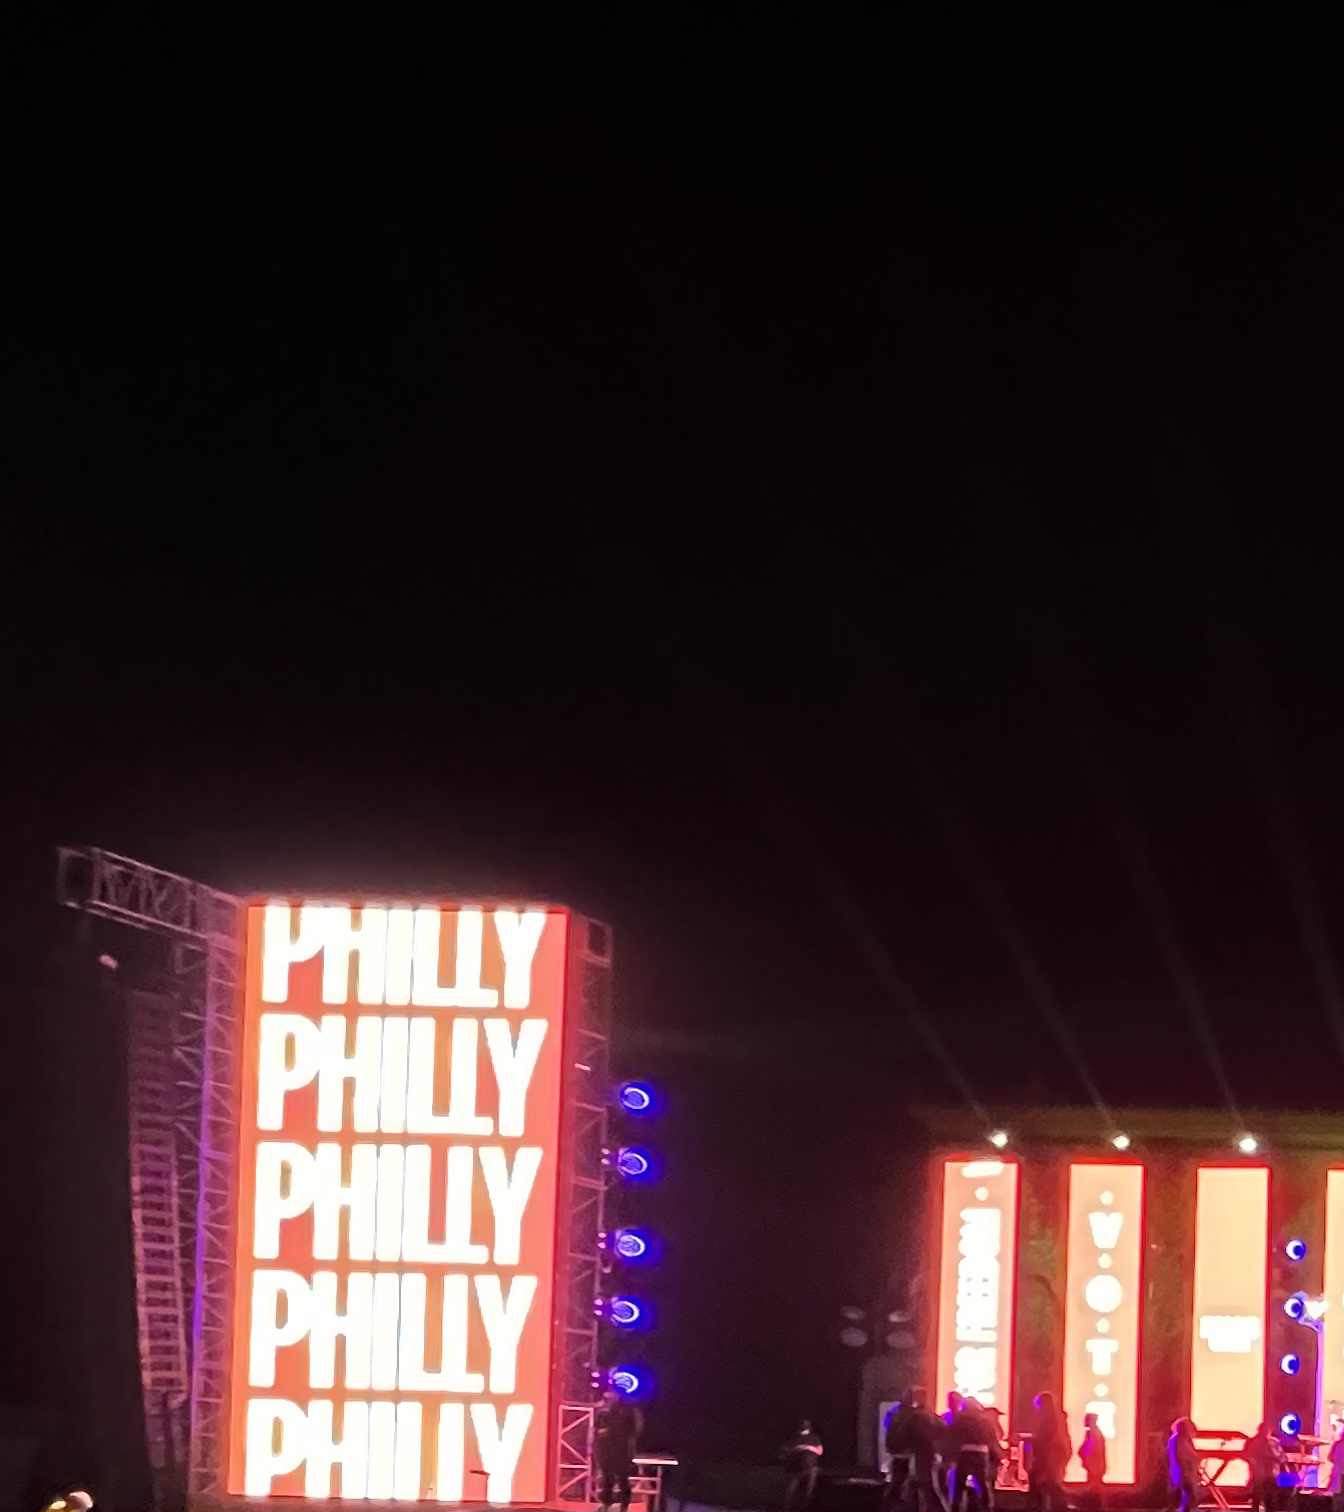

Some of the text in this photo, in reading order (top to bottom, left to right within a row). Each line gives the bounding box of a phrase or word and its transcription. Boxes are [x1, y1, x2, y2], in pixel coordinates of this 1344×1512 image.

[262, 901, 547, 1009] PHILLY
[256, 1013, 548, 1137] PHILLY
[253, 1141, 544, 1265] PHILLY
[249, 1269, 538, 1394] PHILLY
[245, 1398, 534, 1504] PHILLY
